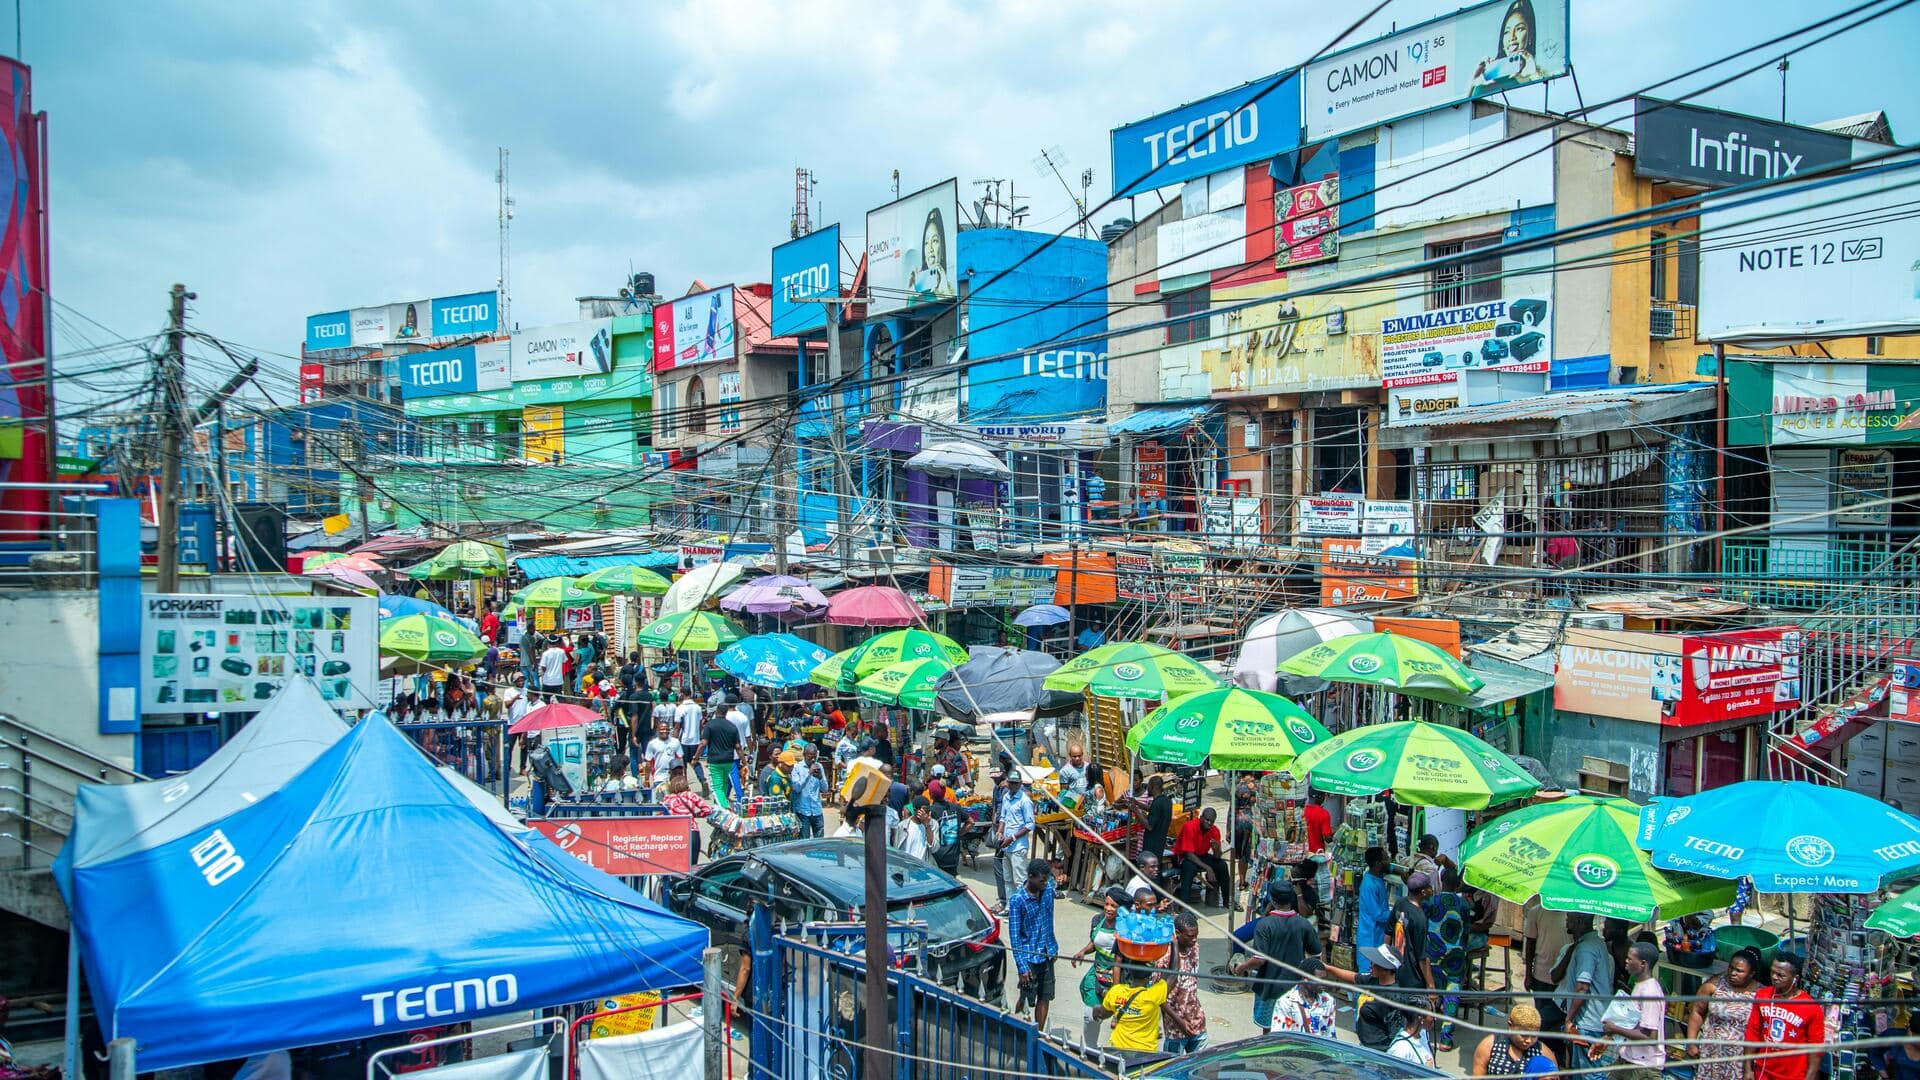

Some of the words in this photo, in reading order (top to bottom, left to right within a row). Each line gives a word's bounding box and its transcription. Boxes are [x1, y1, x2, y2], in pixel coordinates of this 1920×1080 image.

[1327, 50, 1397, 92] CAMON
[1407, 42, 1423, 64] 19
[1433, 36, 1445, 48] 5G
[1335, 100, 1351, 110] Every
[1352, 92, 1375, 104] Moment
[1376, 85, 1398, 97] Portrait
[1400, 78, 1420, 90] Master
[1143, 101, 1258, 172] TECNO
[1691, 127, 1802, 179] Infinix
[1740, 246, 1803, 272] NOTE
[1810, 243, 1835, 265] 12
[782, 263, 829, 302] TECNO
[441, 303, 489, 324] TECNO
[1382, 302, 1506, 334] EMMATECH
[314, 323, 346, 338] TECNO
[1383, 331, 1419, 345] PROJECTORS
[1426, 326, 1465, 339] AUDIOVISUAL
[1466, 320, 1496, 333] COMPANY
[528, 339, 557, 354] CAMON
[1384, 349, 1416, 357] PROJECTOR
[410, 359, 462, 386] TECNO
[1260, 367, 1299, 385] PLAZA
[1384, 362, 1422, 370] INSTALLATION
[978, 427, 1016, 435] TRUE
[1019, 426, 1066, 435] WORLD
[1782, 417, 1821, 430] PHONE
[149, 599, 223, 611] VORWART
[1178, 717, 1199, 728] glo
[1163, 734, 1195, 744] Unlimited
[613, 835, 649, 843] Register,
[630, 843, 668, 851] Recharge
[669, 843, 688, 851] your
[1684, 836, 1744, 860] TECNO
[1667, 853, 1701, 868] Expect
[1702, 862, 1730, 874] More
[1775, 873, 1820, 888] Expect
[1824, 873, 1858, 888] More
[361, 973, 518, 1027] TECNO
[1760, 1006, 1803, 1027] FREEDOM
